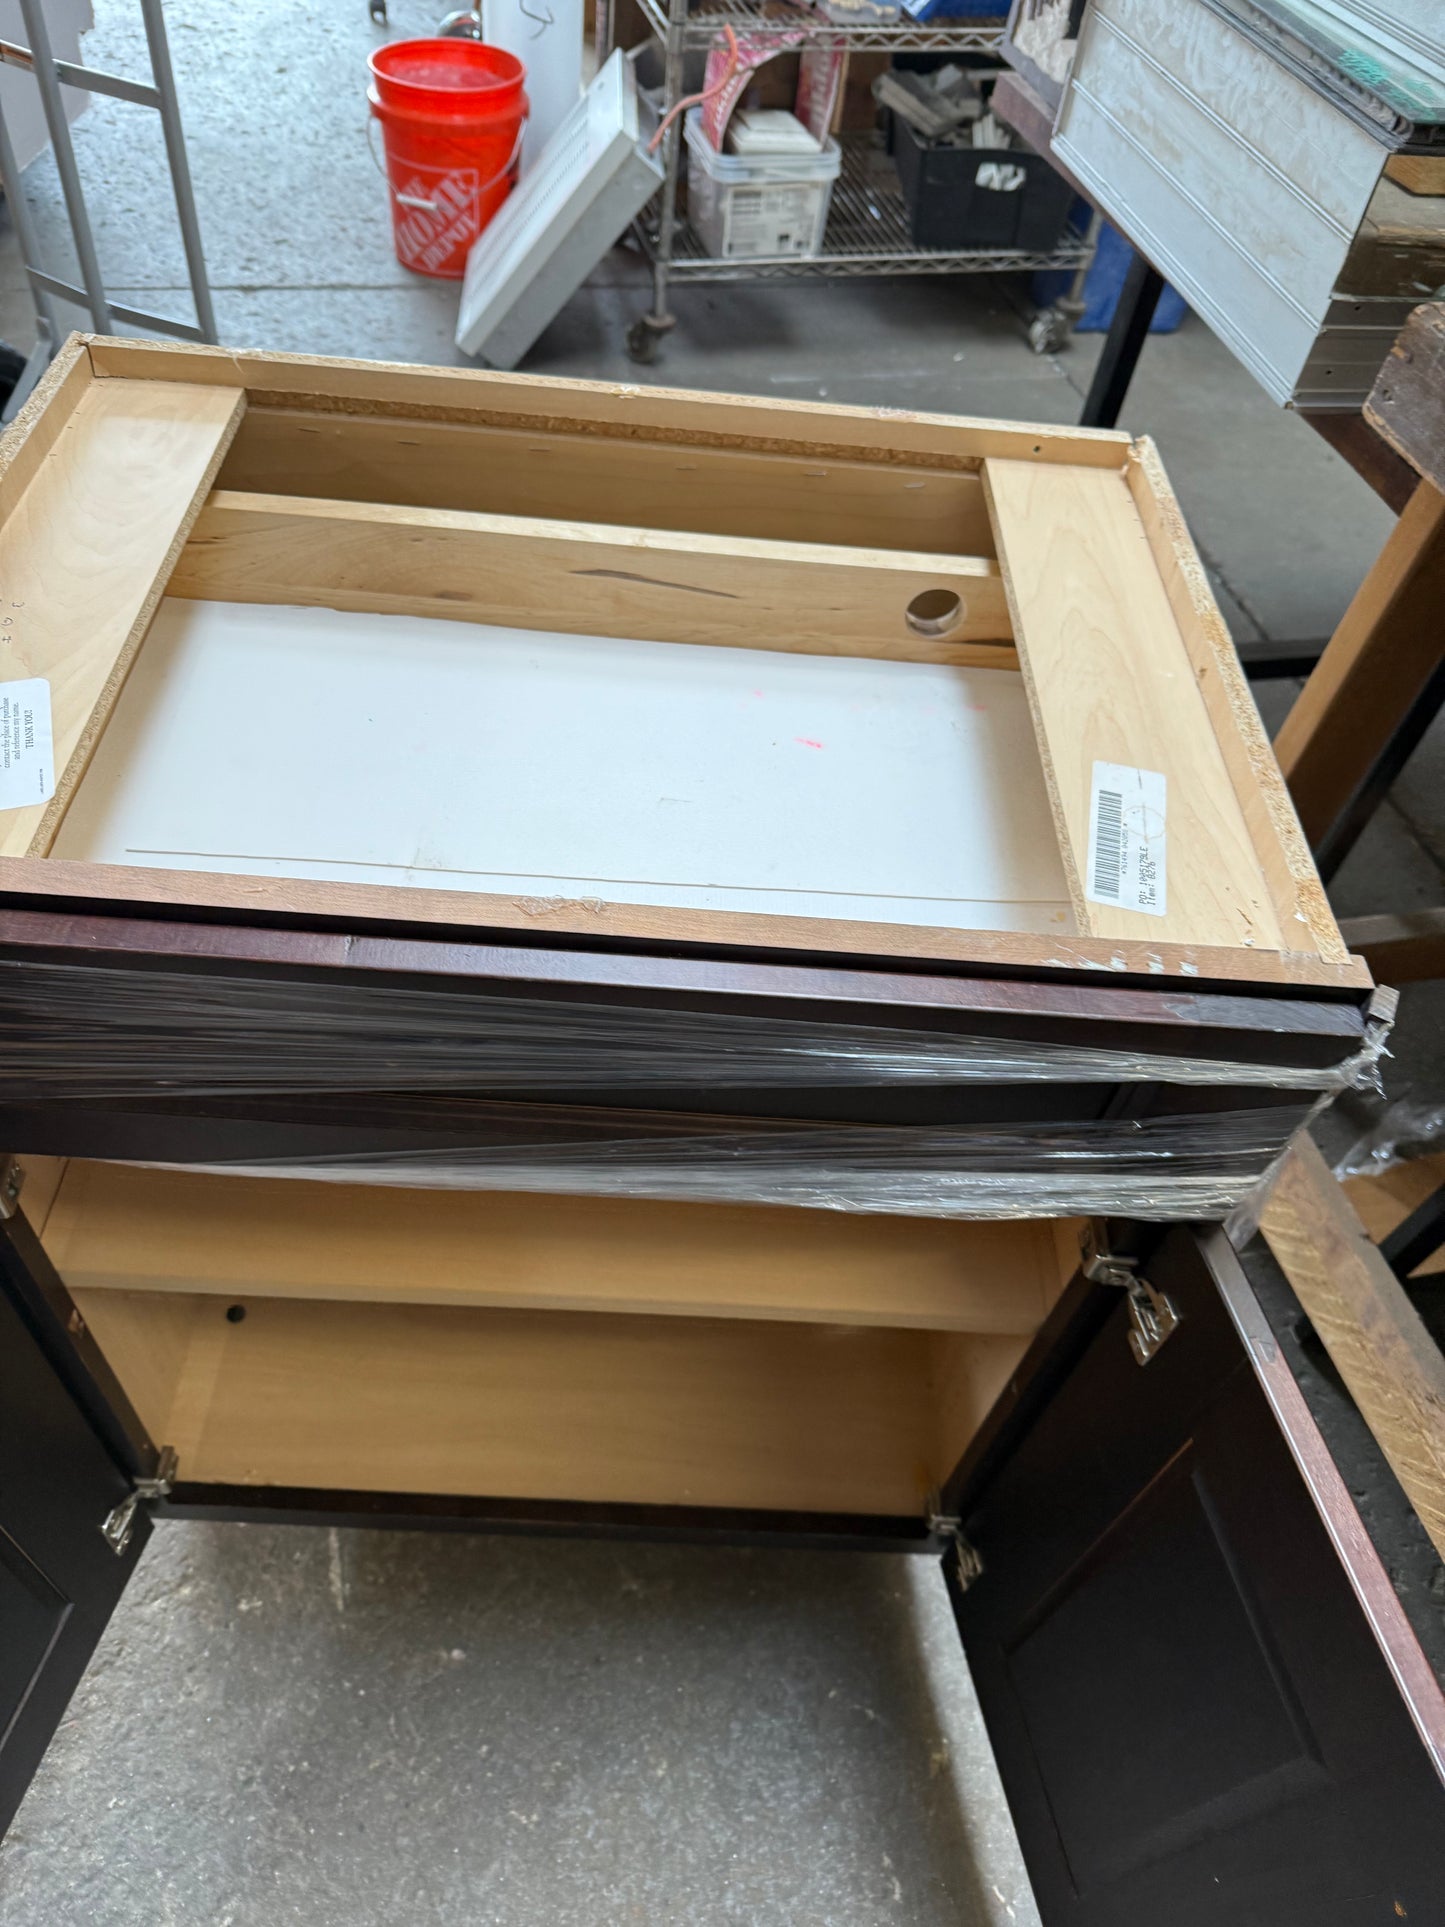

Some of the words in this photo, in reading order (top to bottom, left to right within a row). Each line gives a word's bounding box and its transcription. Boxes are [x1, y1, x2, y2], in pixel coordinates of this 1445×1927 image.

[397, 171, 472, 263] HOME
[420, 214, 476, 271] DEPOT
[24, 709, 33, 725] YOU!
[25, 725, 34, 749] THANK
[1138, 890, 1146, 905] PO:
[1147, 883, 1156, 906] Item:
